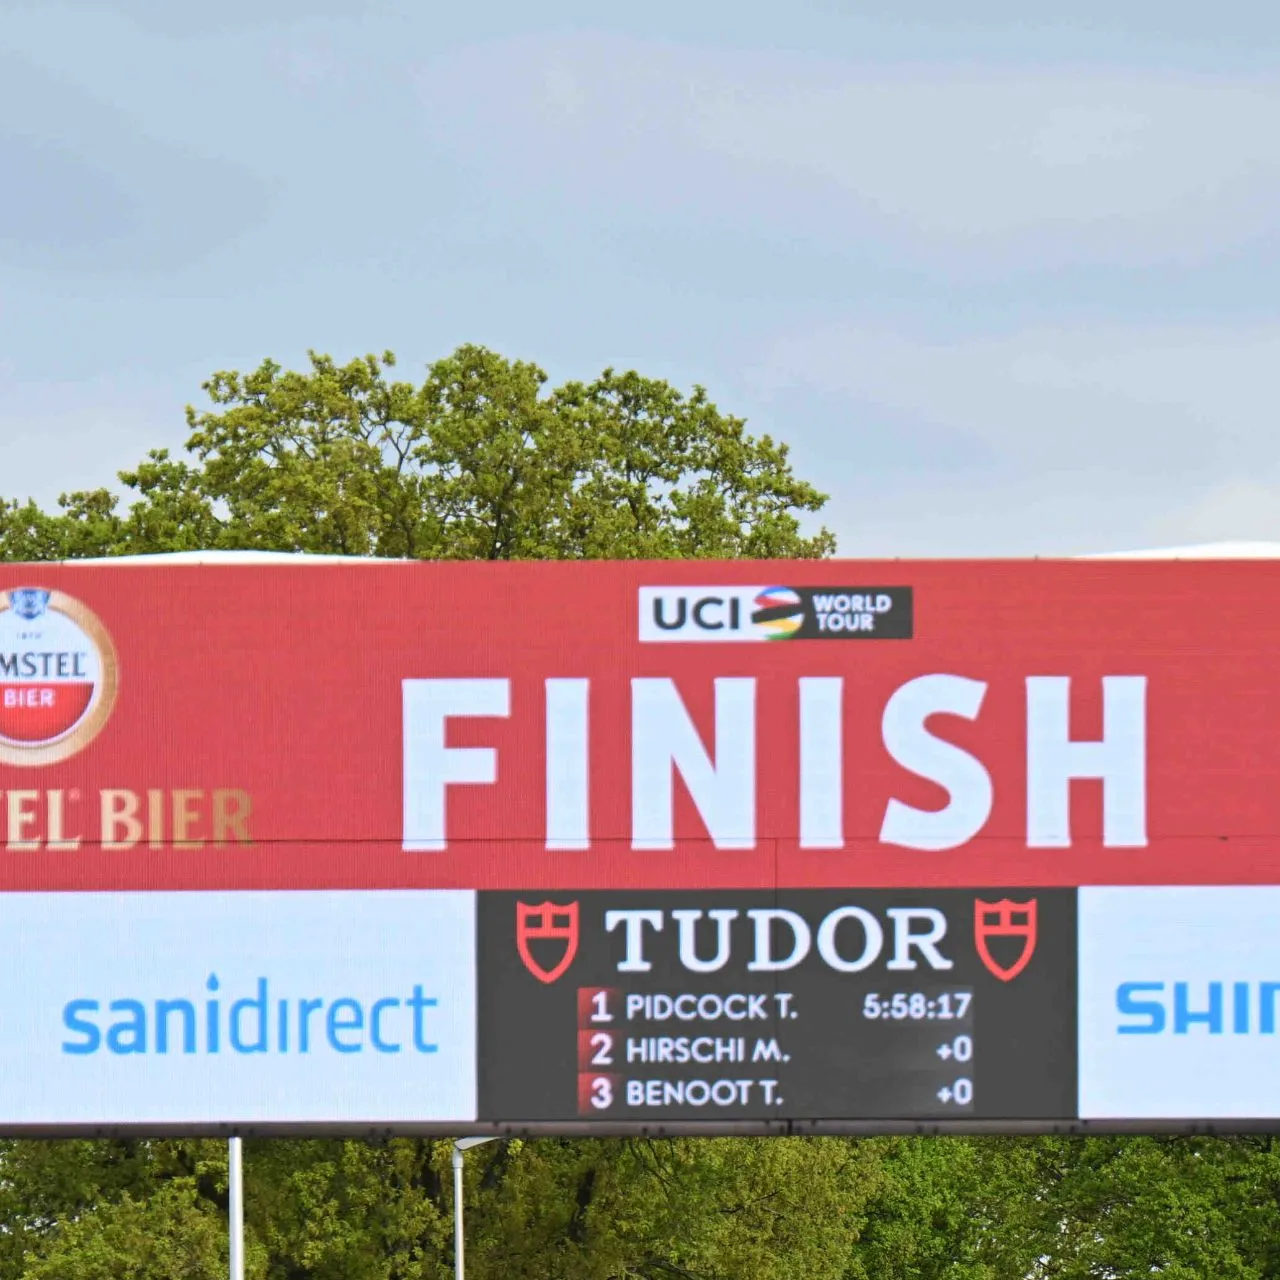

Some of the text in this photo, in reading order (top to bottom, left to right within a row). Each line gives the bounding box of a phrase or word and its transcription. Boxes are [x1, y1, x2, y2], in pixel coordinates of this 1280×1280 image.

[653, 596, 740, 630] UCI
[812, 594, 893, 613] WORLD
[817, 613, 874, 631] TOUR
[4, 688, 56, 708] BIER
[402, 673, 1148, 852] FINISH
[99, 787, 257, 850] BIER
[605, 906, 954, 973] TUDOR
[61, 972, 439, 1055] sanidirect
[590, 990, 614, 1022] 1
[626, 993, 768, 1021] PIDCOCK
[774, 992, 799, 1020] T.
[590, 1032, 972, 1066] 2 HIRSCHI M. +0
[590, 1077, 973, 1110] 3 BENOOT T. +0
